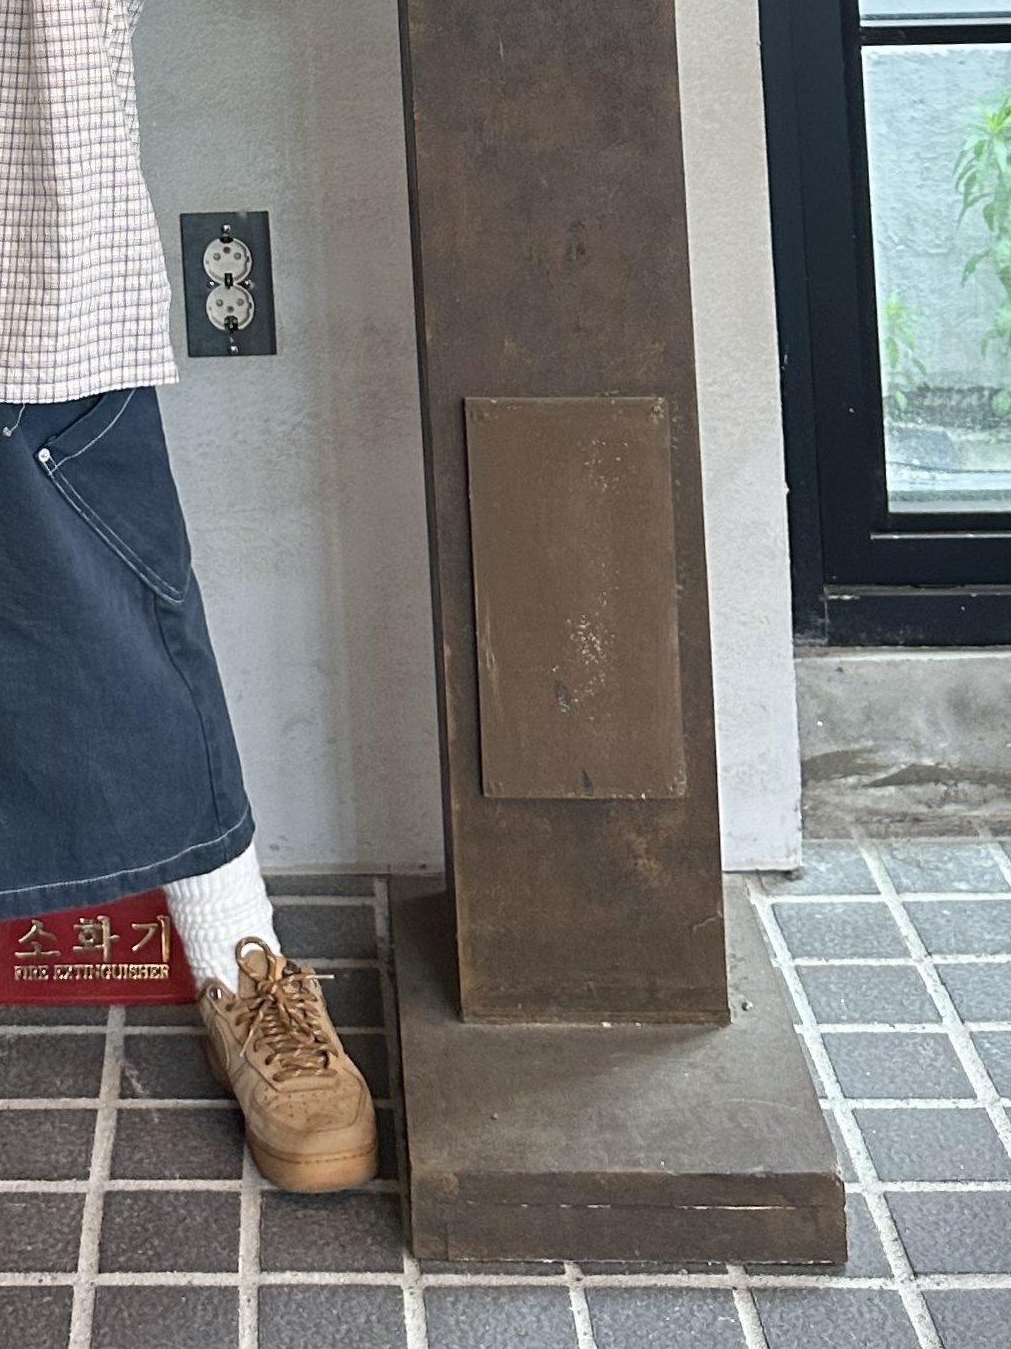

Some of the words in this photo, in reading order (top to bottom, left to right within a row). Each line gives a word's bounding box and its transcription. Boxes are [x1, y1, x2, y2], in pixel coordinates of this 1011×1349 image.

[14, 914, 171, 962] 소화기
[14, 964, 49, 981] FIRE
[53, 963, 170, 980] EXTINGUISHER
